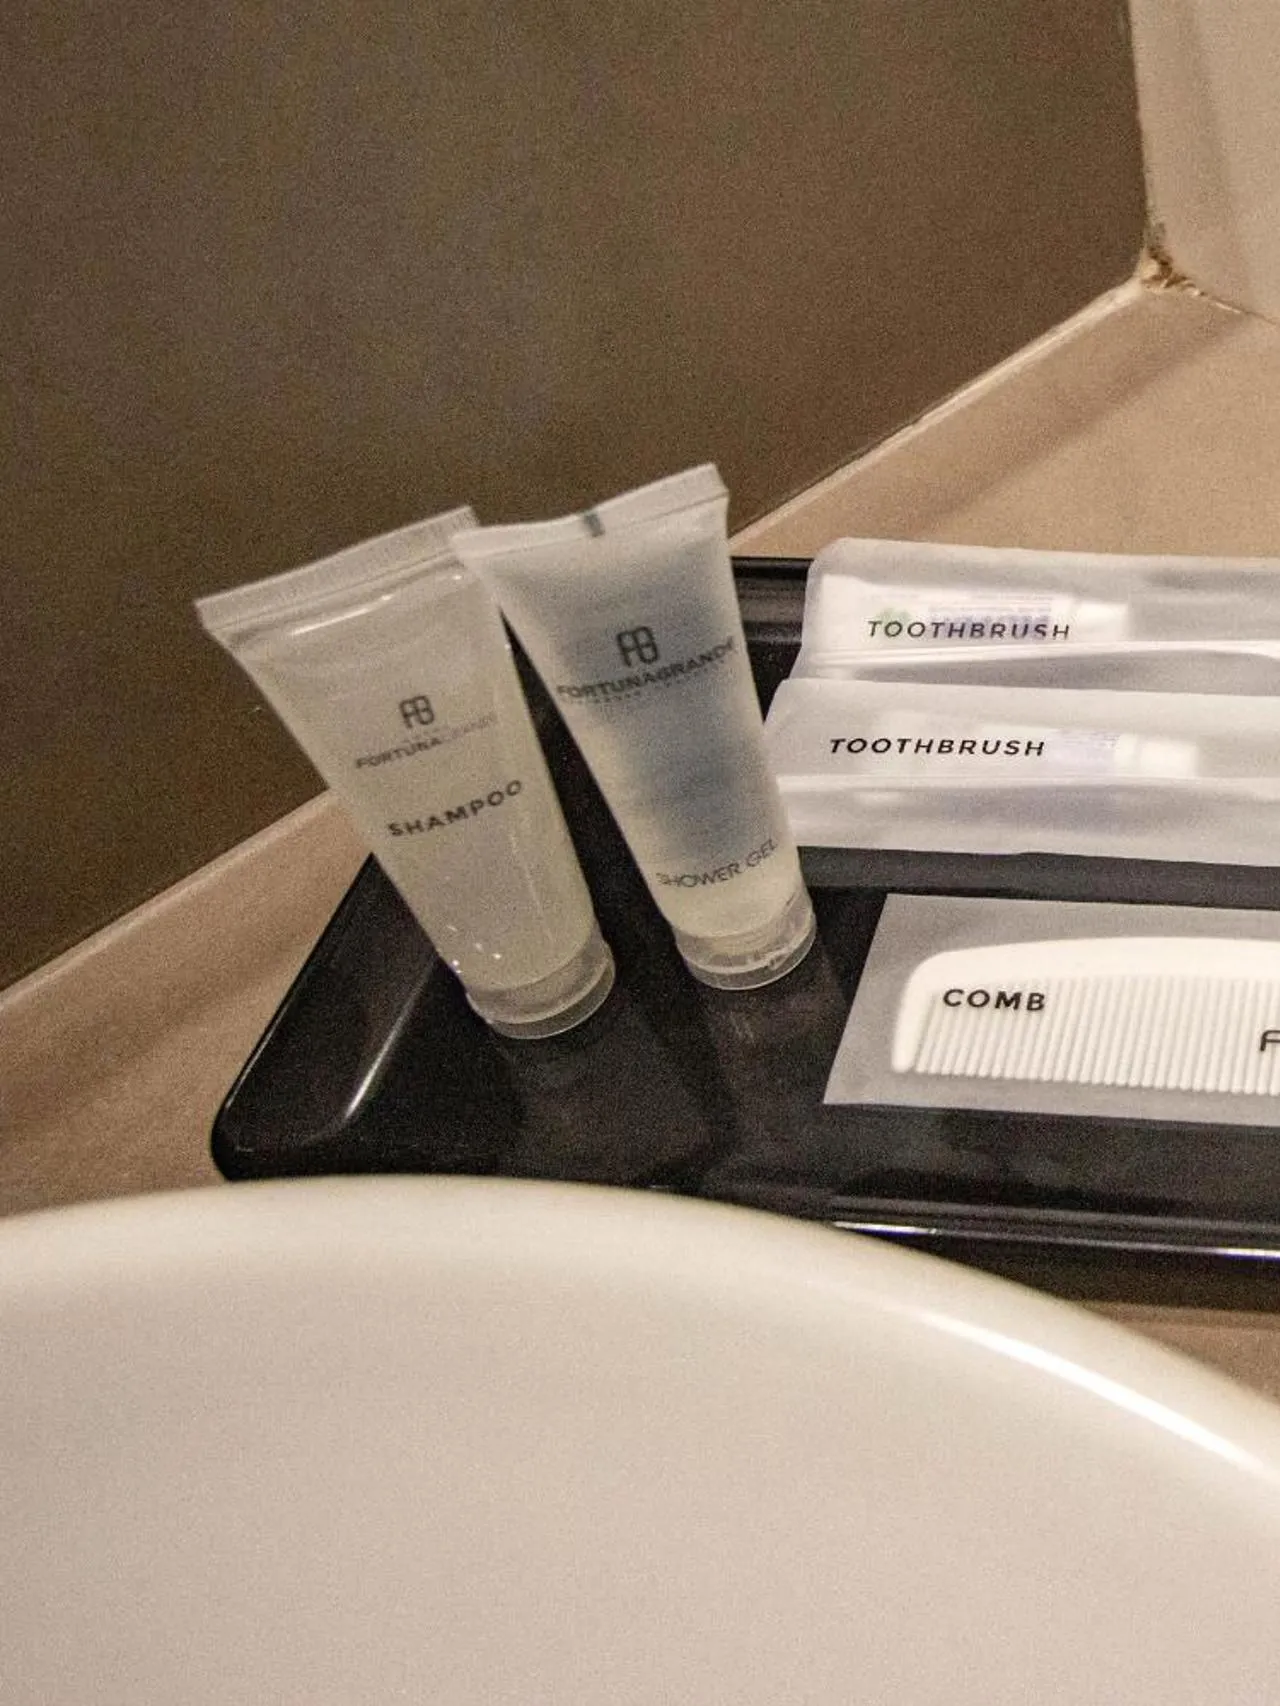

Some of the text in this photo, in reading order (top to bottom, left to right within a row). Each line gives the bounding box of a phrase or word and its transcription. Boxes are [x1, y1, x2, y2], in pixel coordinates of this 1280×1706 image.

[867, 619, 1070, 641] TOOTHBRUSH
[830, 737, 1045, 756] TOOTHBRUSH
[388, 779, 522, 837] SHAMPOO
[656, 861, 744, 888] SHOWER
[943, 988, 1046, 1012] COMB
